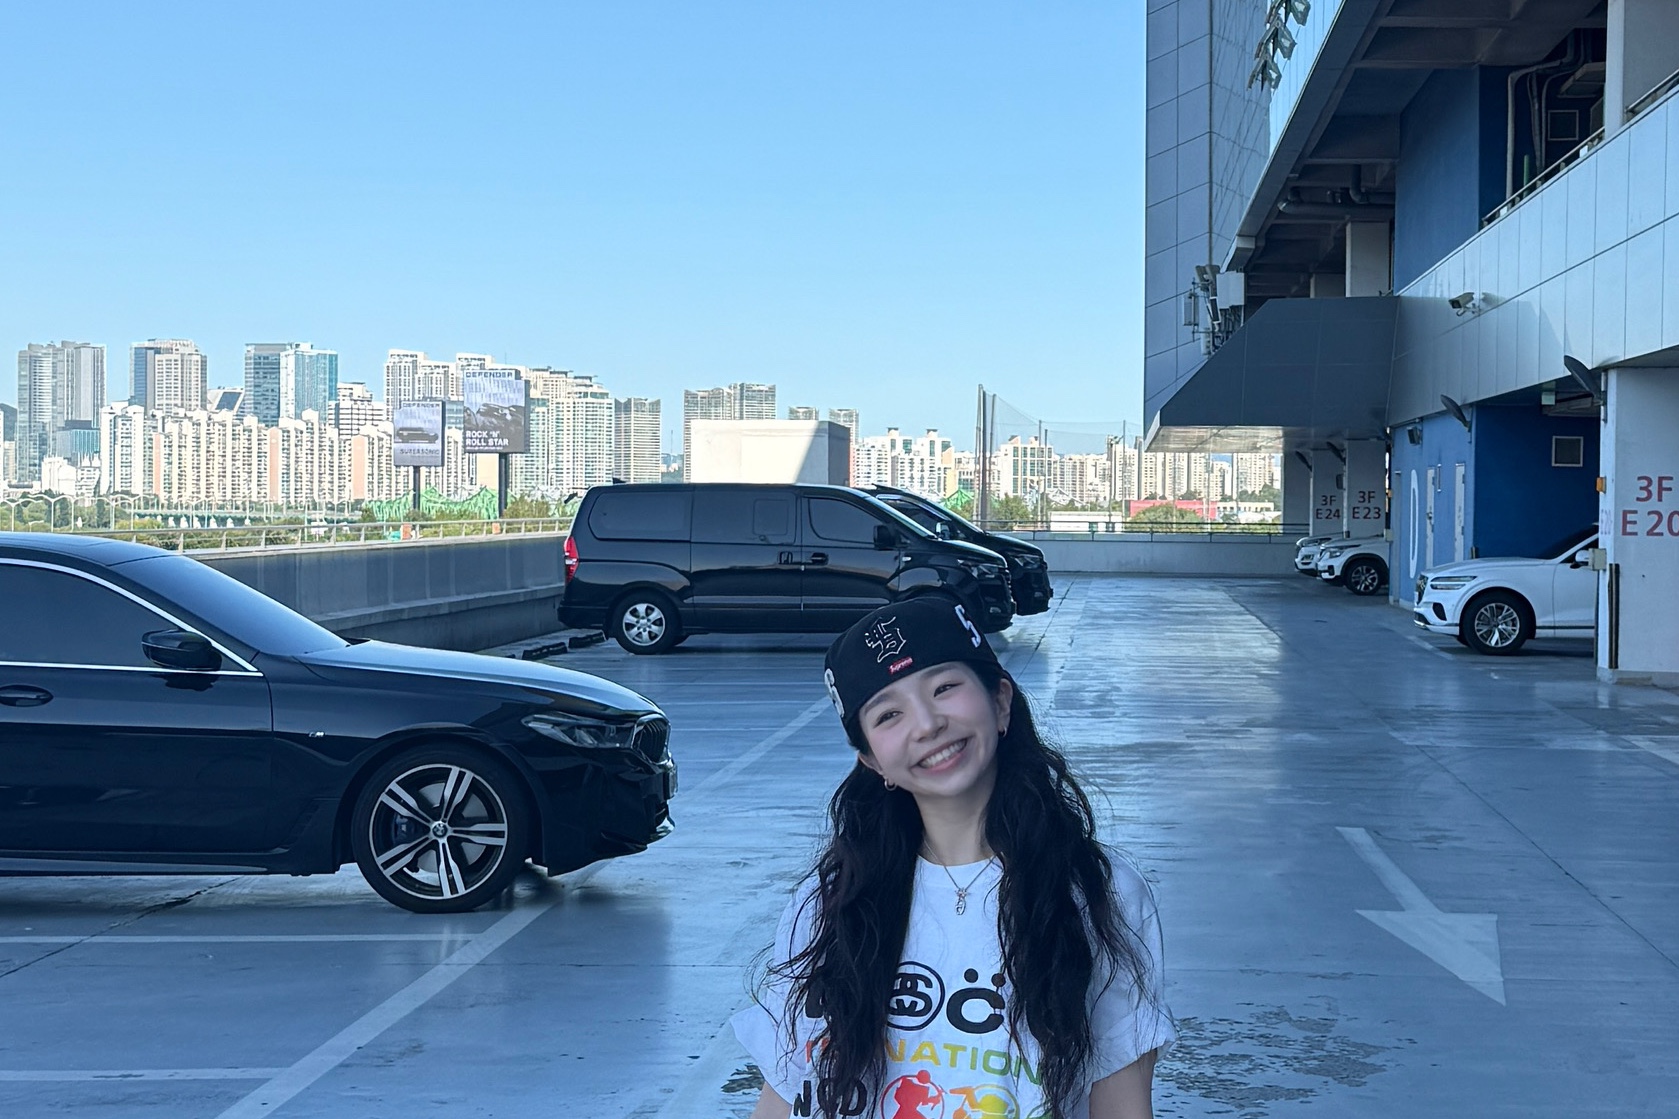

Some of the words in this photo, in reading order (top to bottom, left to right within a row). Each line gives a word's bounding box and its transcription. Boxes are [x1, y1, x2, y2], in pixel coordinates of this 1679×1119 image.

[465, 430, 488, 438] ROCK
[465, 438, 487, 446] ROLL
[488, 438, 509, 446] STAR
[1636, 475, 1674, 503] 3F
[1321, 495, 1337, 506] 3F
[1358, 490, 1376, 504] 3F
[1315, 508, 1341, 520] E24
[1352, 506, 1382, 520] E23
